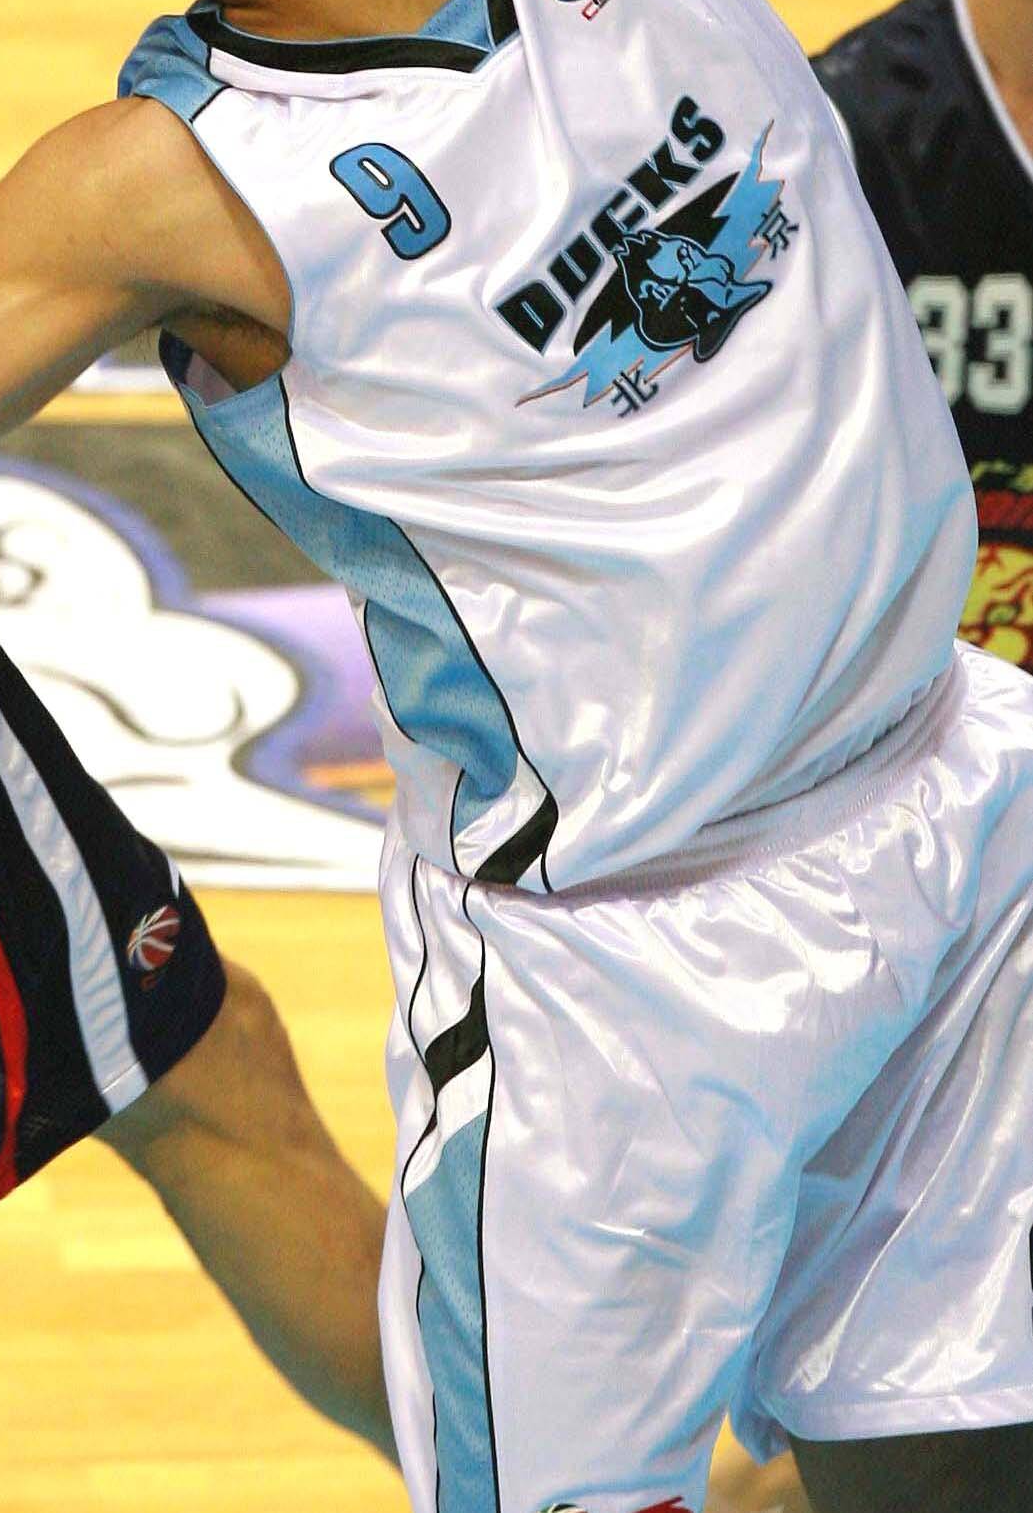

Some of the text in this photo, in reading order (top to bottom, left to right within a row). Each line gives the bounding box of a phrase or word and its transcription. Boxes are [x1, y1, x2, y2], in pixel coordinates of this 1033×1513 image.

[329, 143, 452, 261] 9
[493, 95, 726, 356] DUCKS
[611, 201, 799, 418] 北 京
